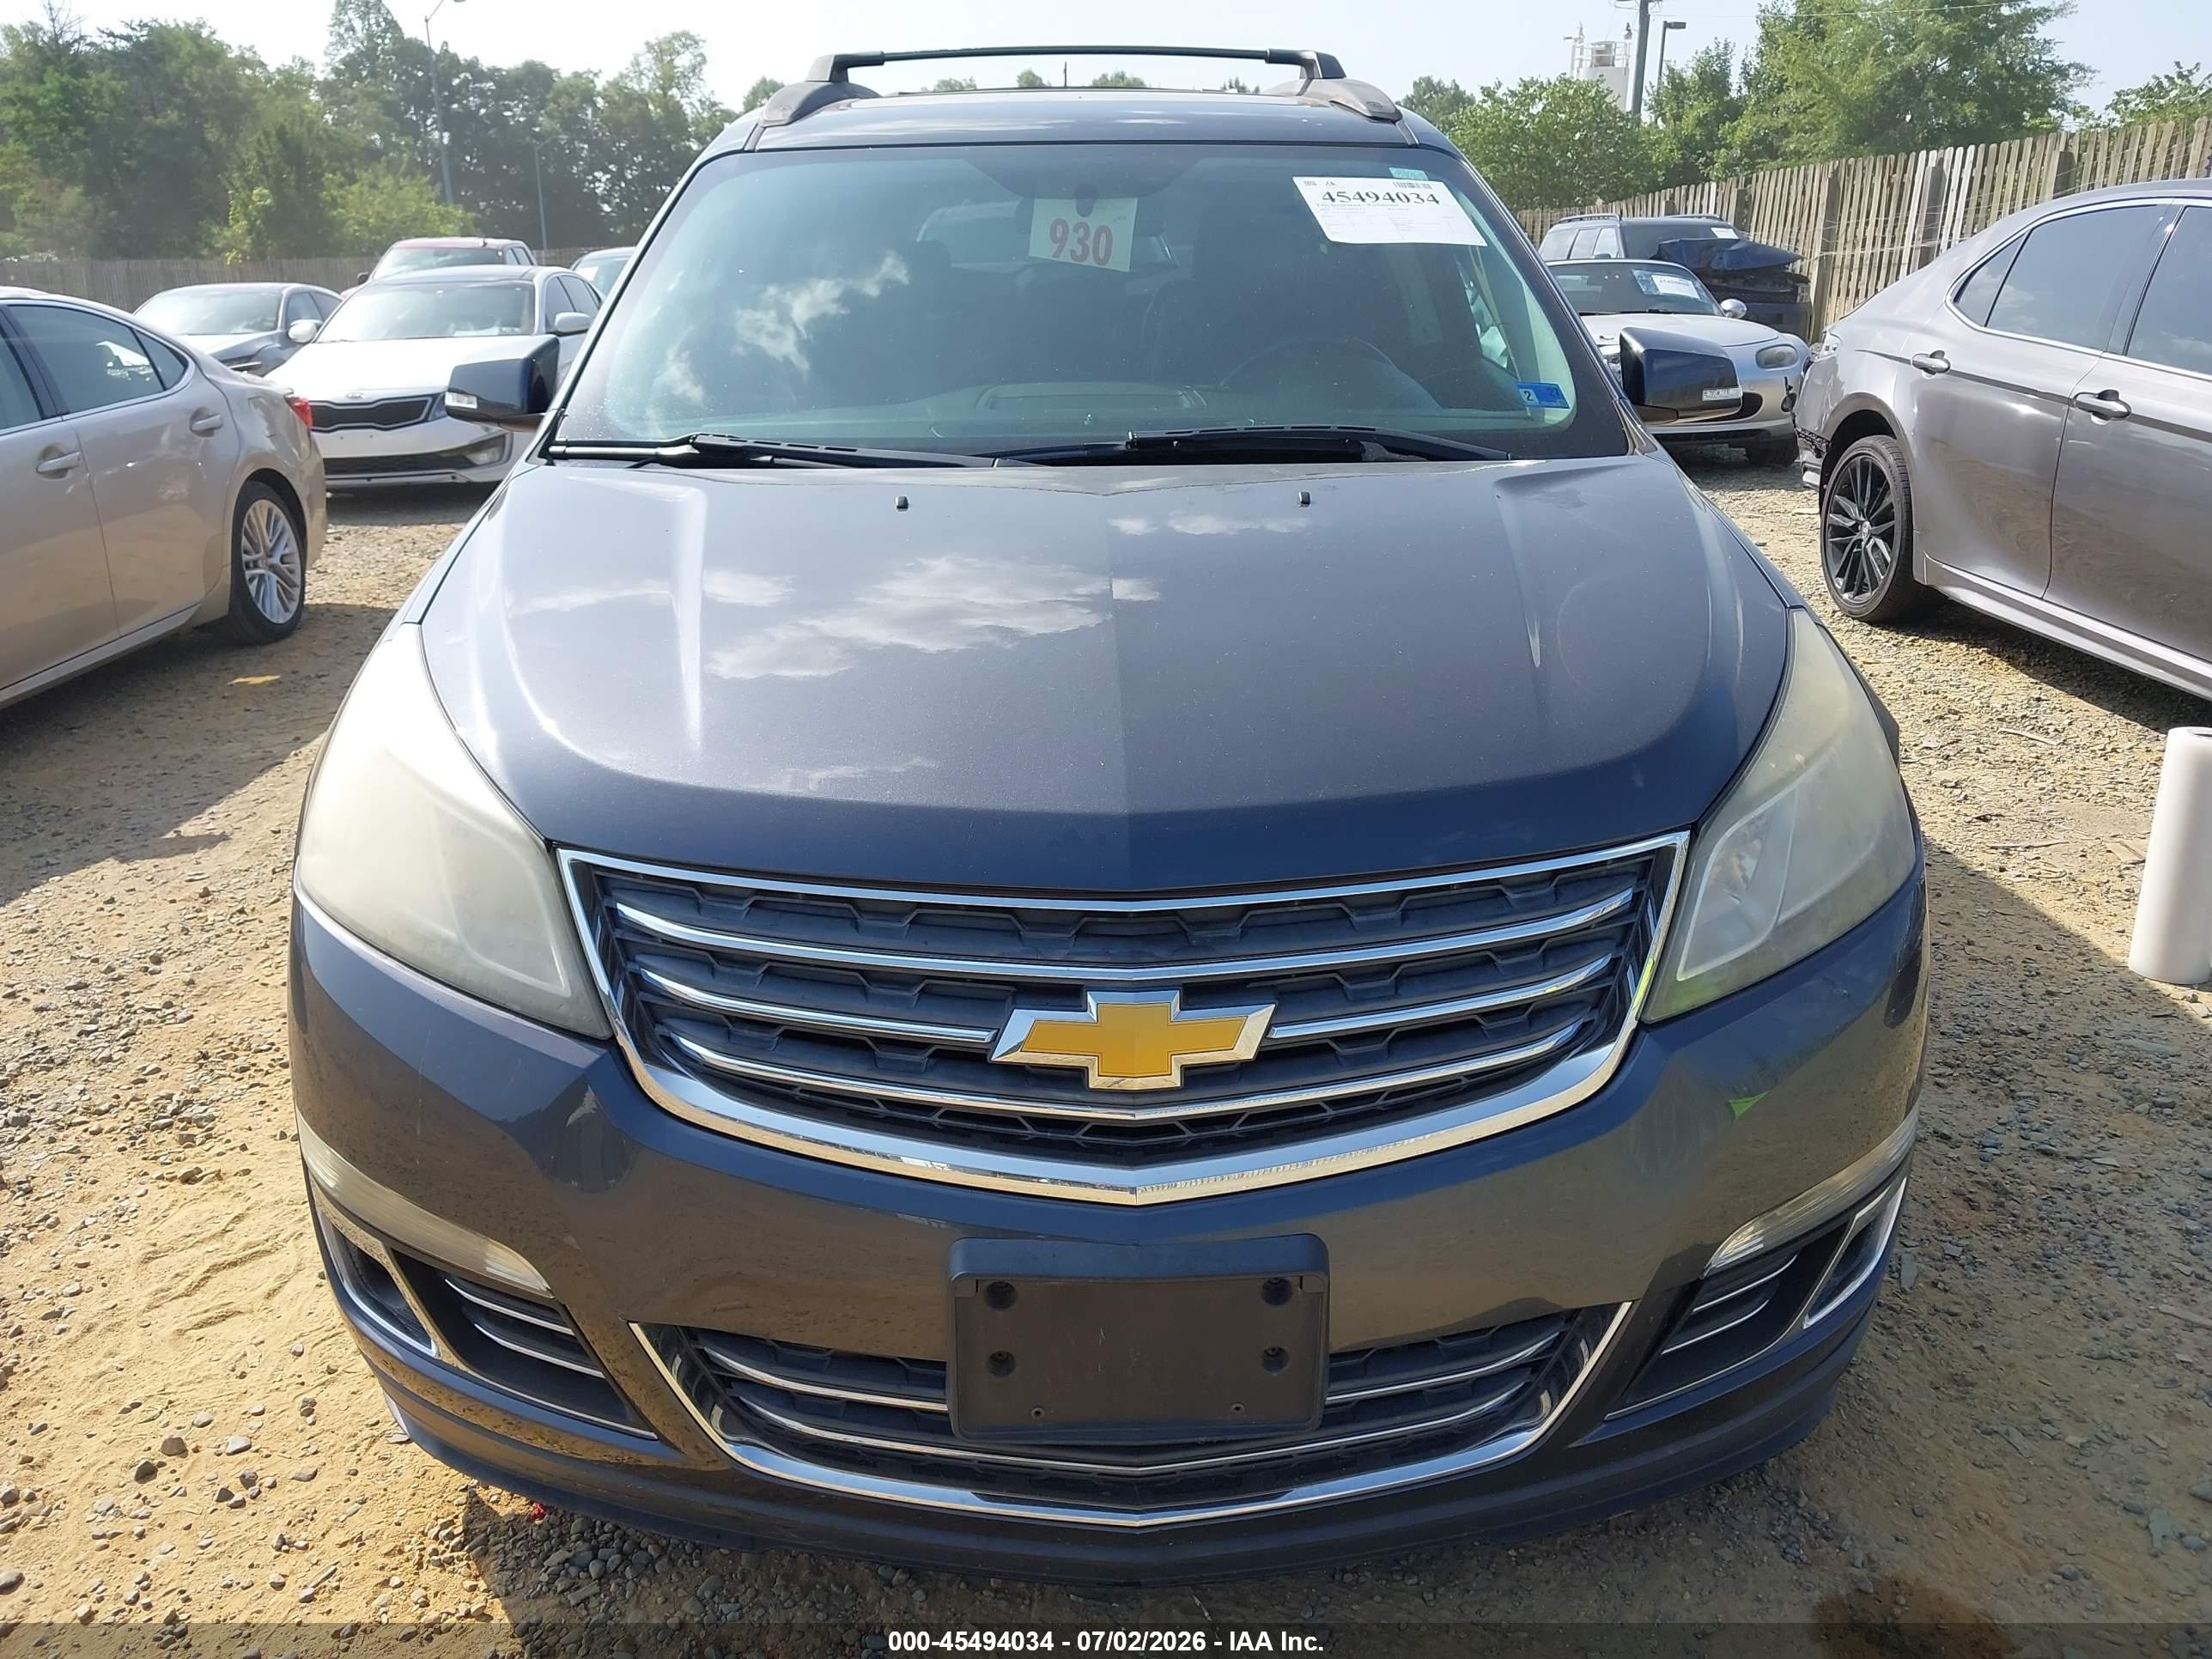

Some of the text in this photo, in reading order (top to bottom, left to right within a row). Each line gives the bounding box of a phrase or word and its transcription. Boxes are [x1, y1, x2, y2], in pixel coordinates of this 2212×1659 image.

[1322, 191, 1440, 205] 45494034
[1049, 218, 1114, 266] 930
[1523, 390, 1534, 402] 2
